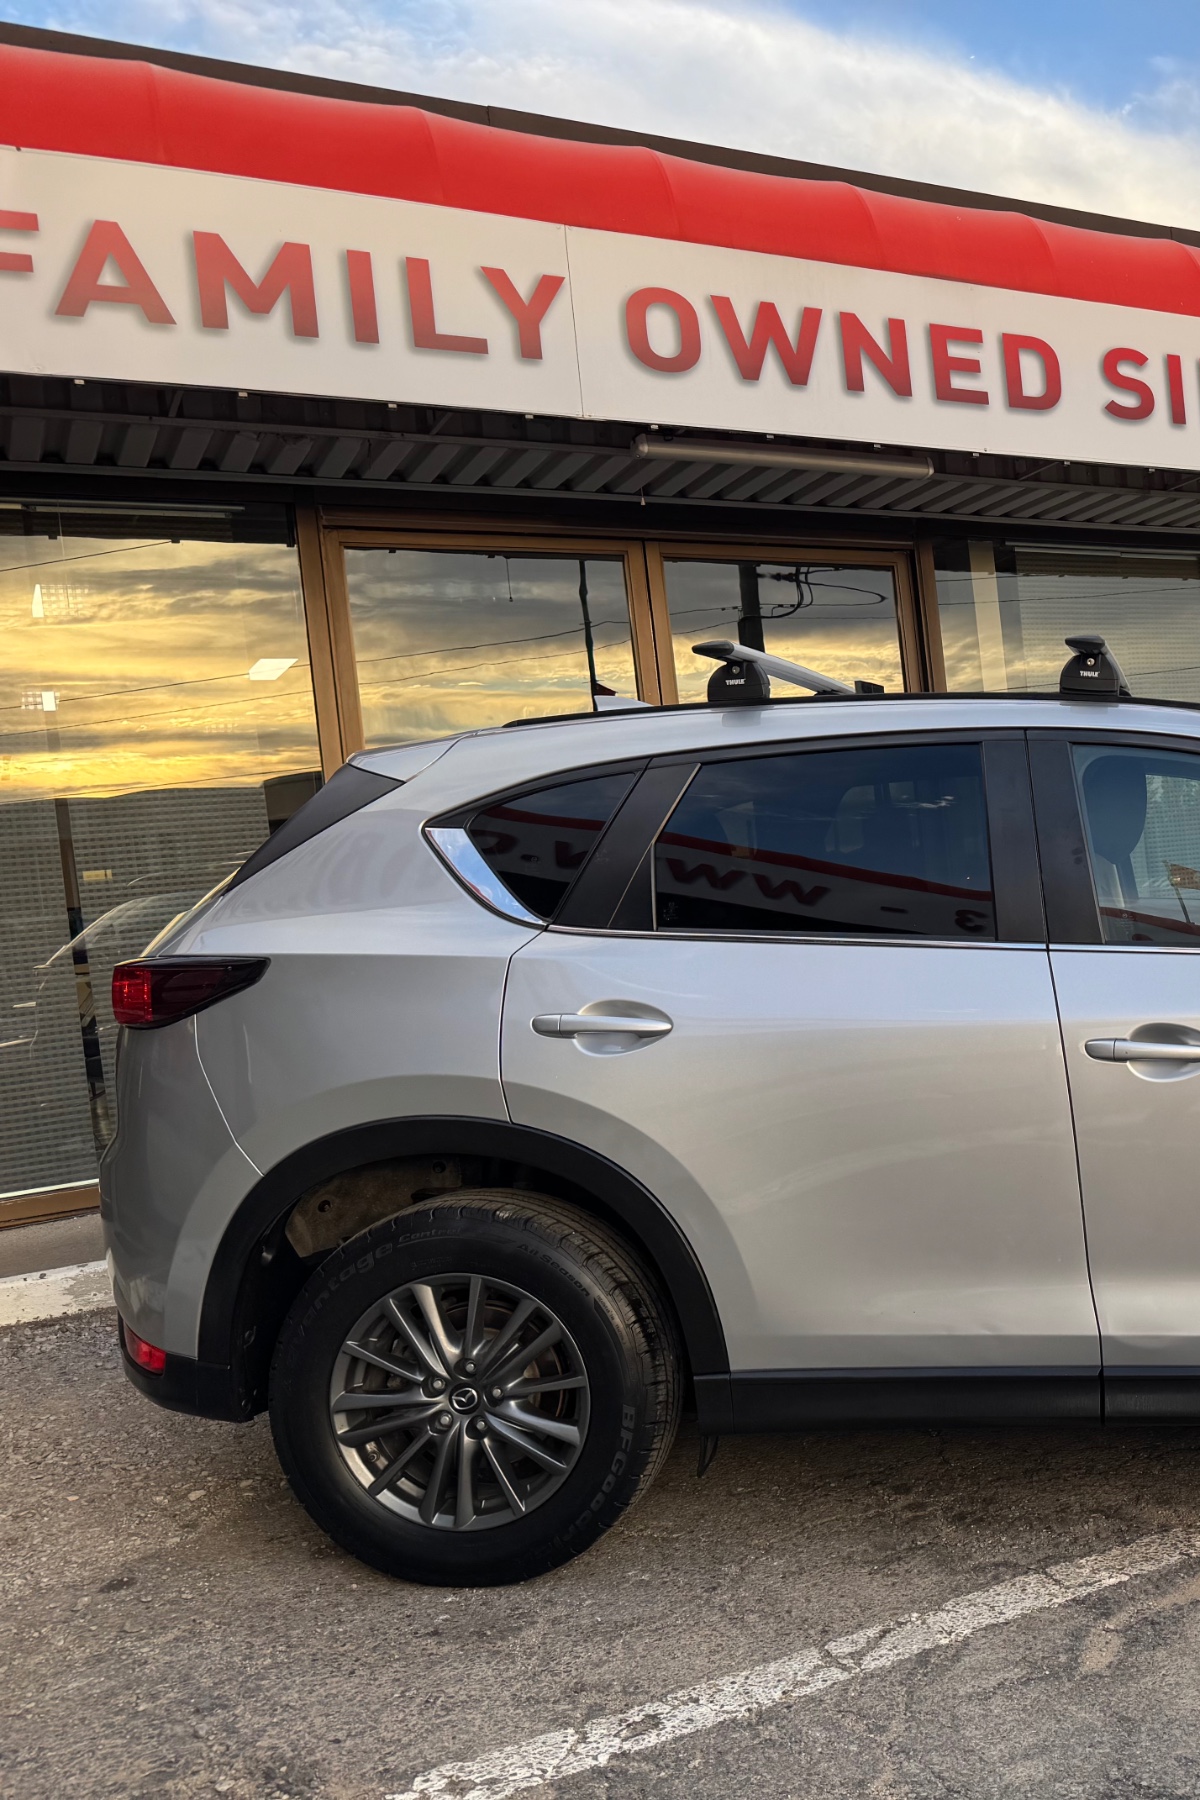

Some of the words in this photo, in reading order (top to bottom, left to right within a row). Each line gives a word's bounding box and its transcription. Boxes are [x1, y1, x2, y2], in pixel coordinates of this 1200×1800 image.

[625, 286, 1062, 411] OWNED
[1080, 670, 1100, 678] THULE
[725, 678, 746, 686] THULE
